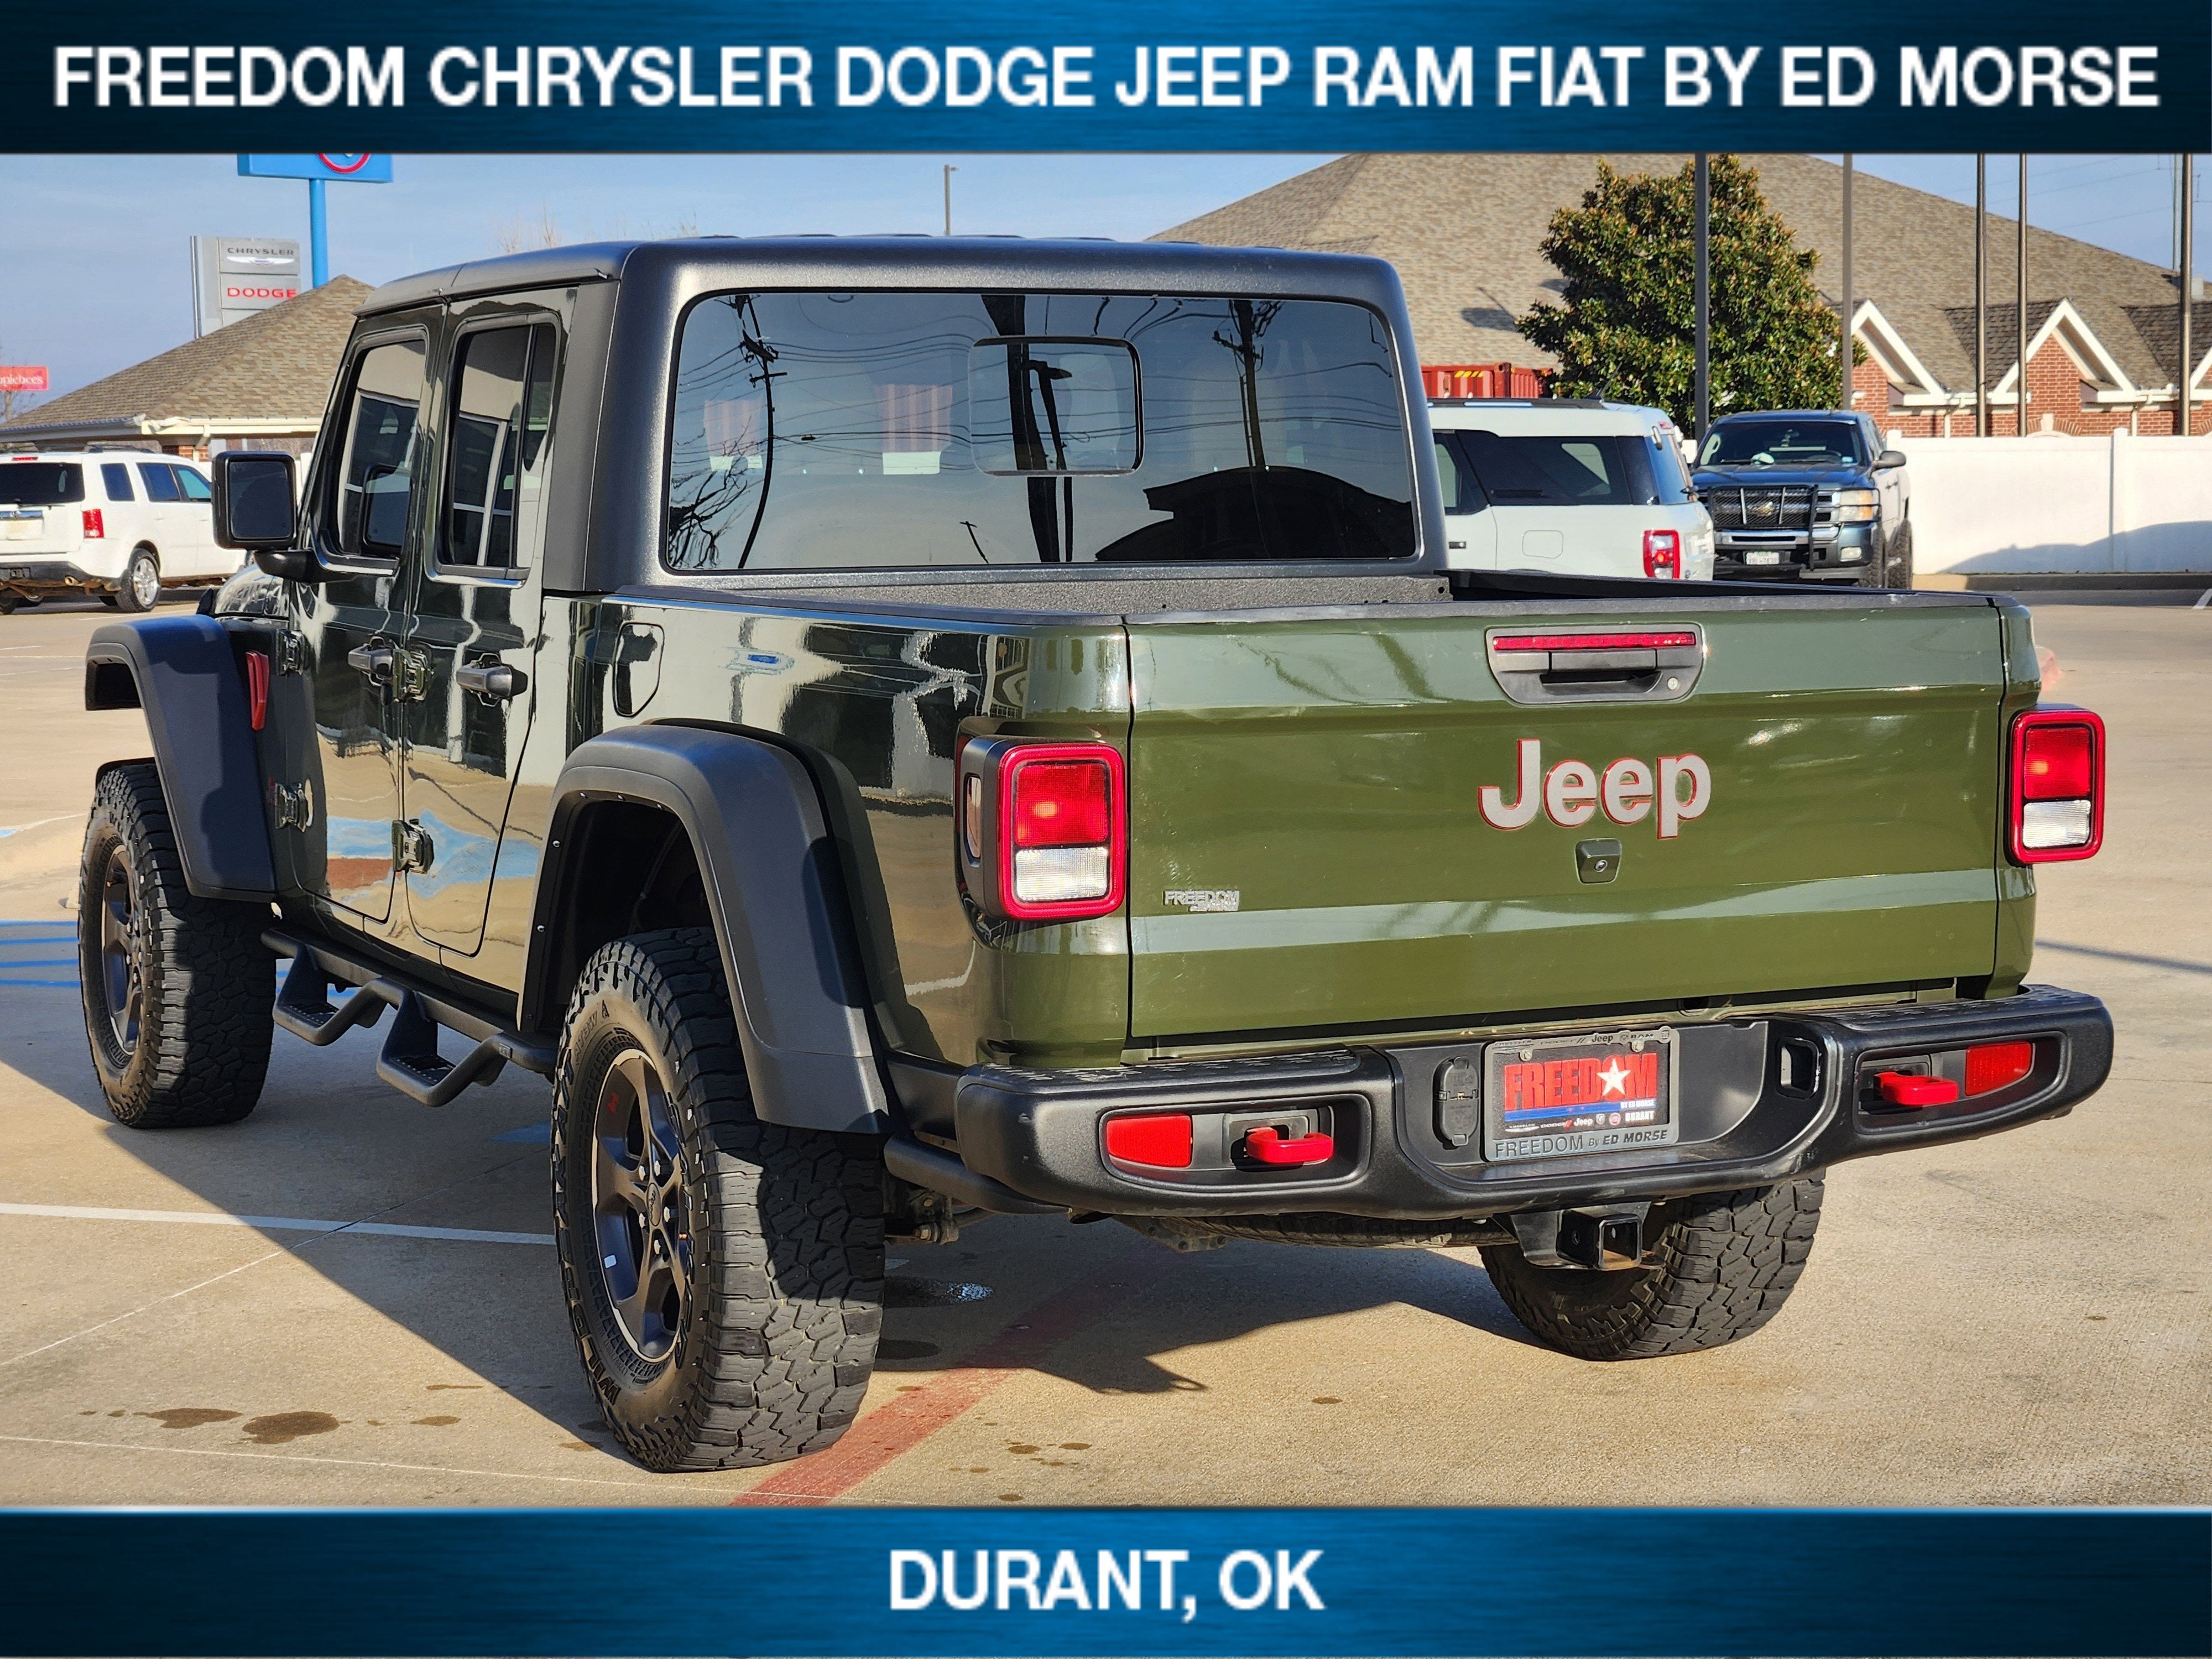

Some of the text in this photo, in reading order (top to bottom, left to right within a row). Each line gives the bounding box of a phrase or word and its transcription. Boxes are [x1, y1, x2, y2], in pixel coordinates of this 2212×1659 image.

[227, 247, 294, 255] CHRYSLER
[227, 287, 297, 298] DODGE
[1478, 737, 1712, 839] Jeep
[1163, 890, 1239, 906] FREEDOM
[1591, 1034, 1614, 1044] Jeep
[1504, 1053, 1657, 1110] FREEDOM
[1625, 1110, 1655, 1122] DURANT
[1574, 1118, 1594, 1127] Jeep
[1495, 1129, 1668, 1159] FREEDOM By ED MORSE
